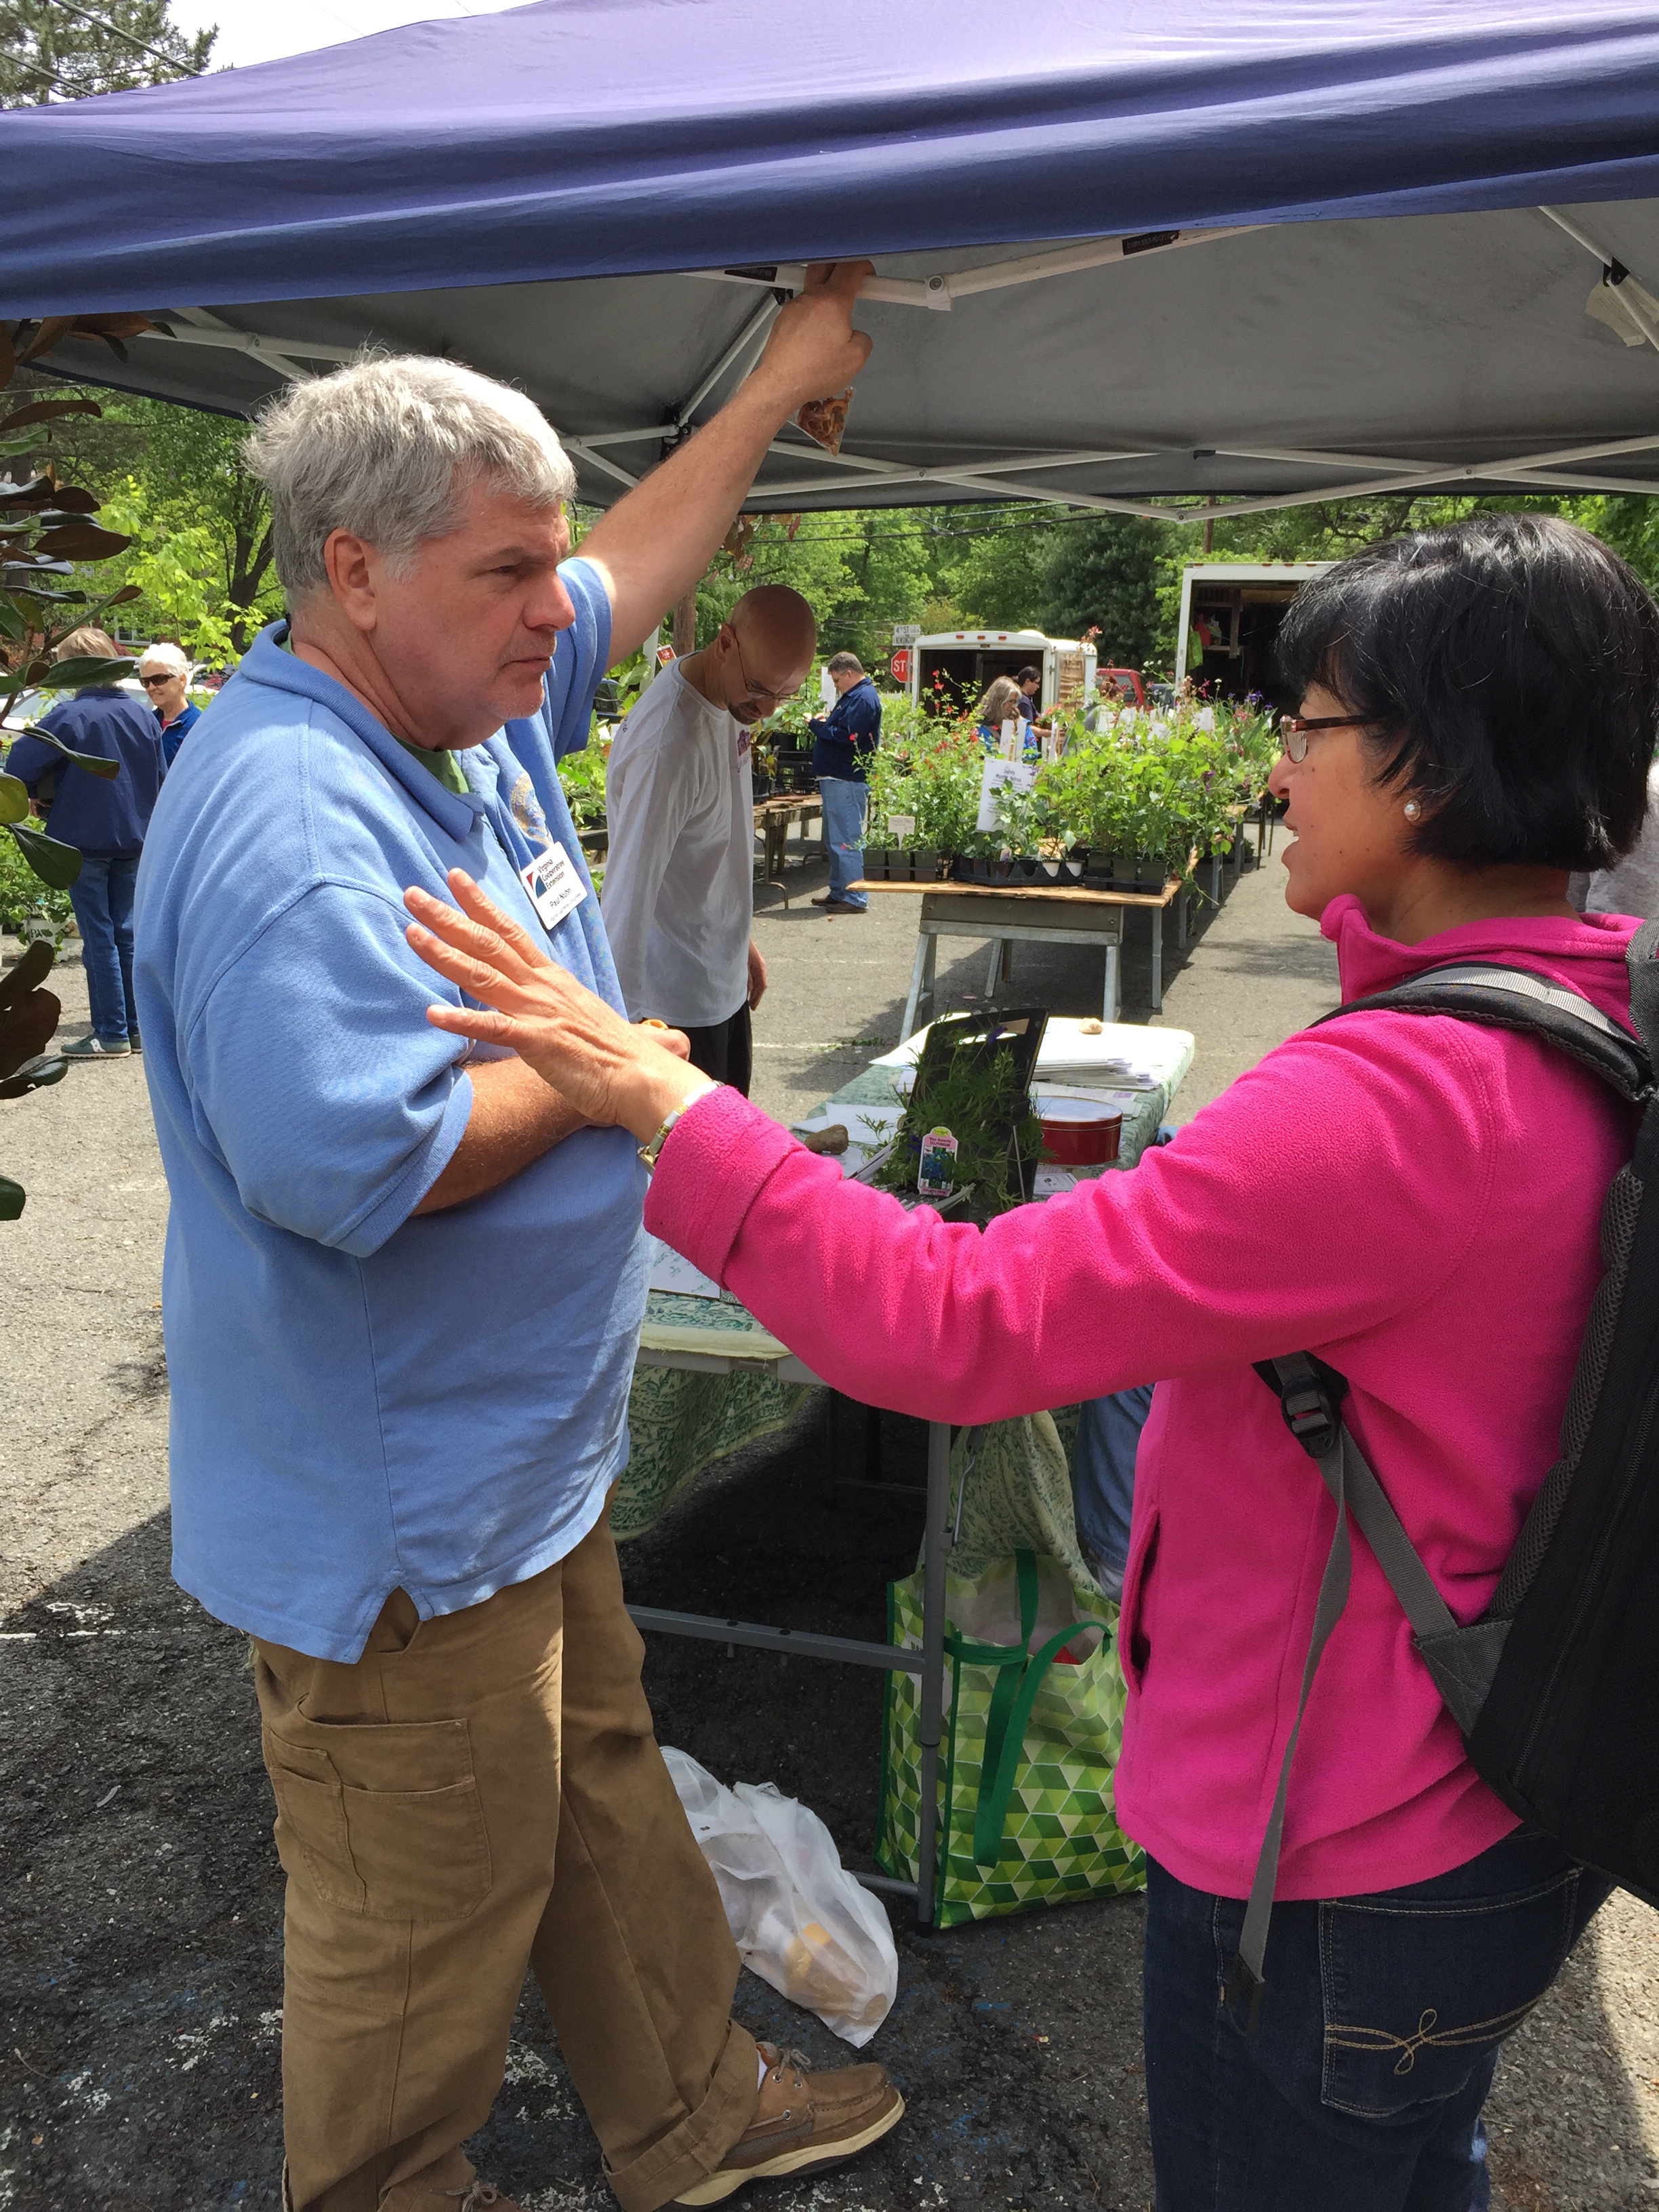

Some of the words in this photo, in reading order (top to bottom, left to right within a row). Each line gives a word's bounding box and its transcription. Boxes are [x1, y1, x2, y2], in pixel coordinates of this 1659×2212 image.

[537, 859, 554, 874] Virginia
[541, 860, 565, 882] Cooperative
[545, 871, 566, 890] Extension
[550, 896, 561, 909] Paul
